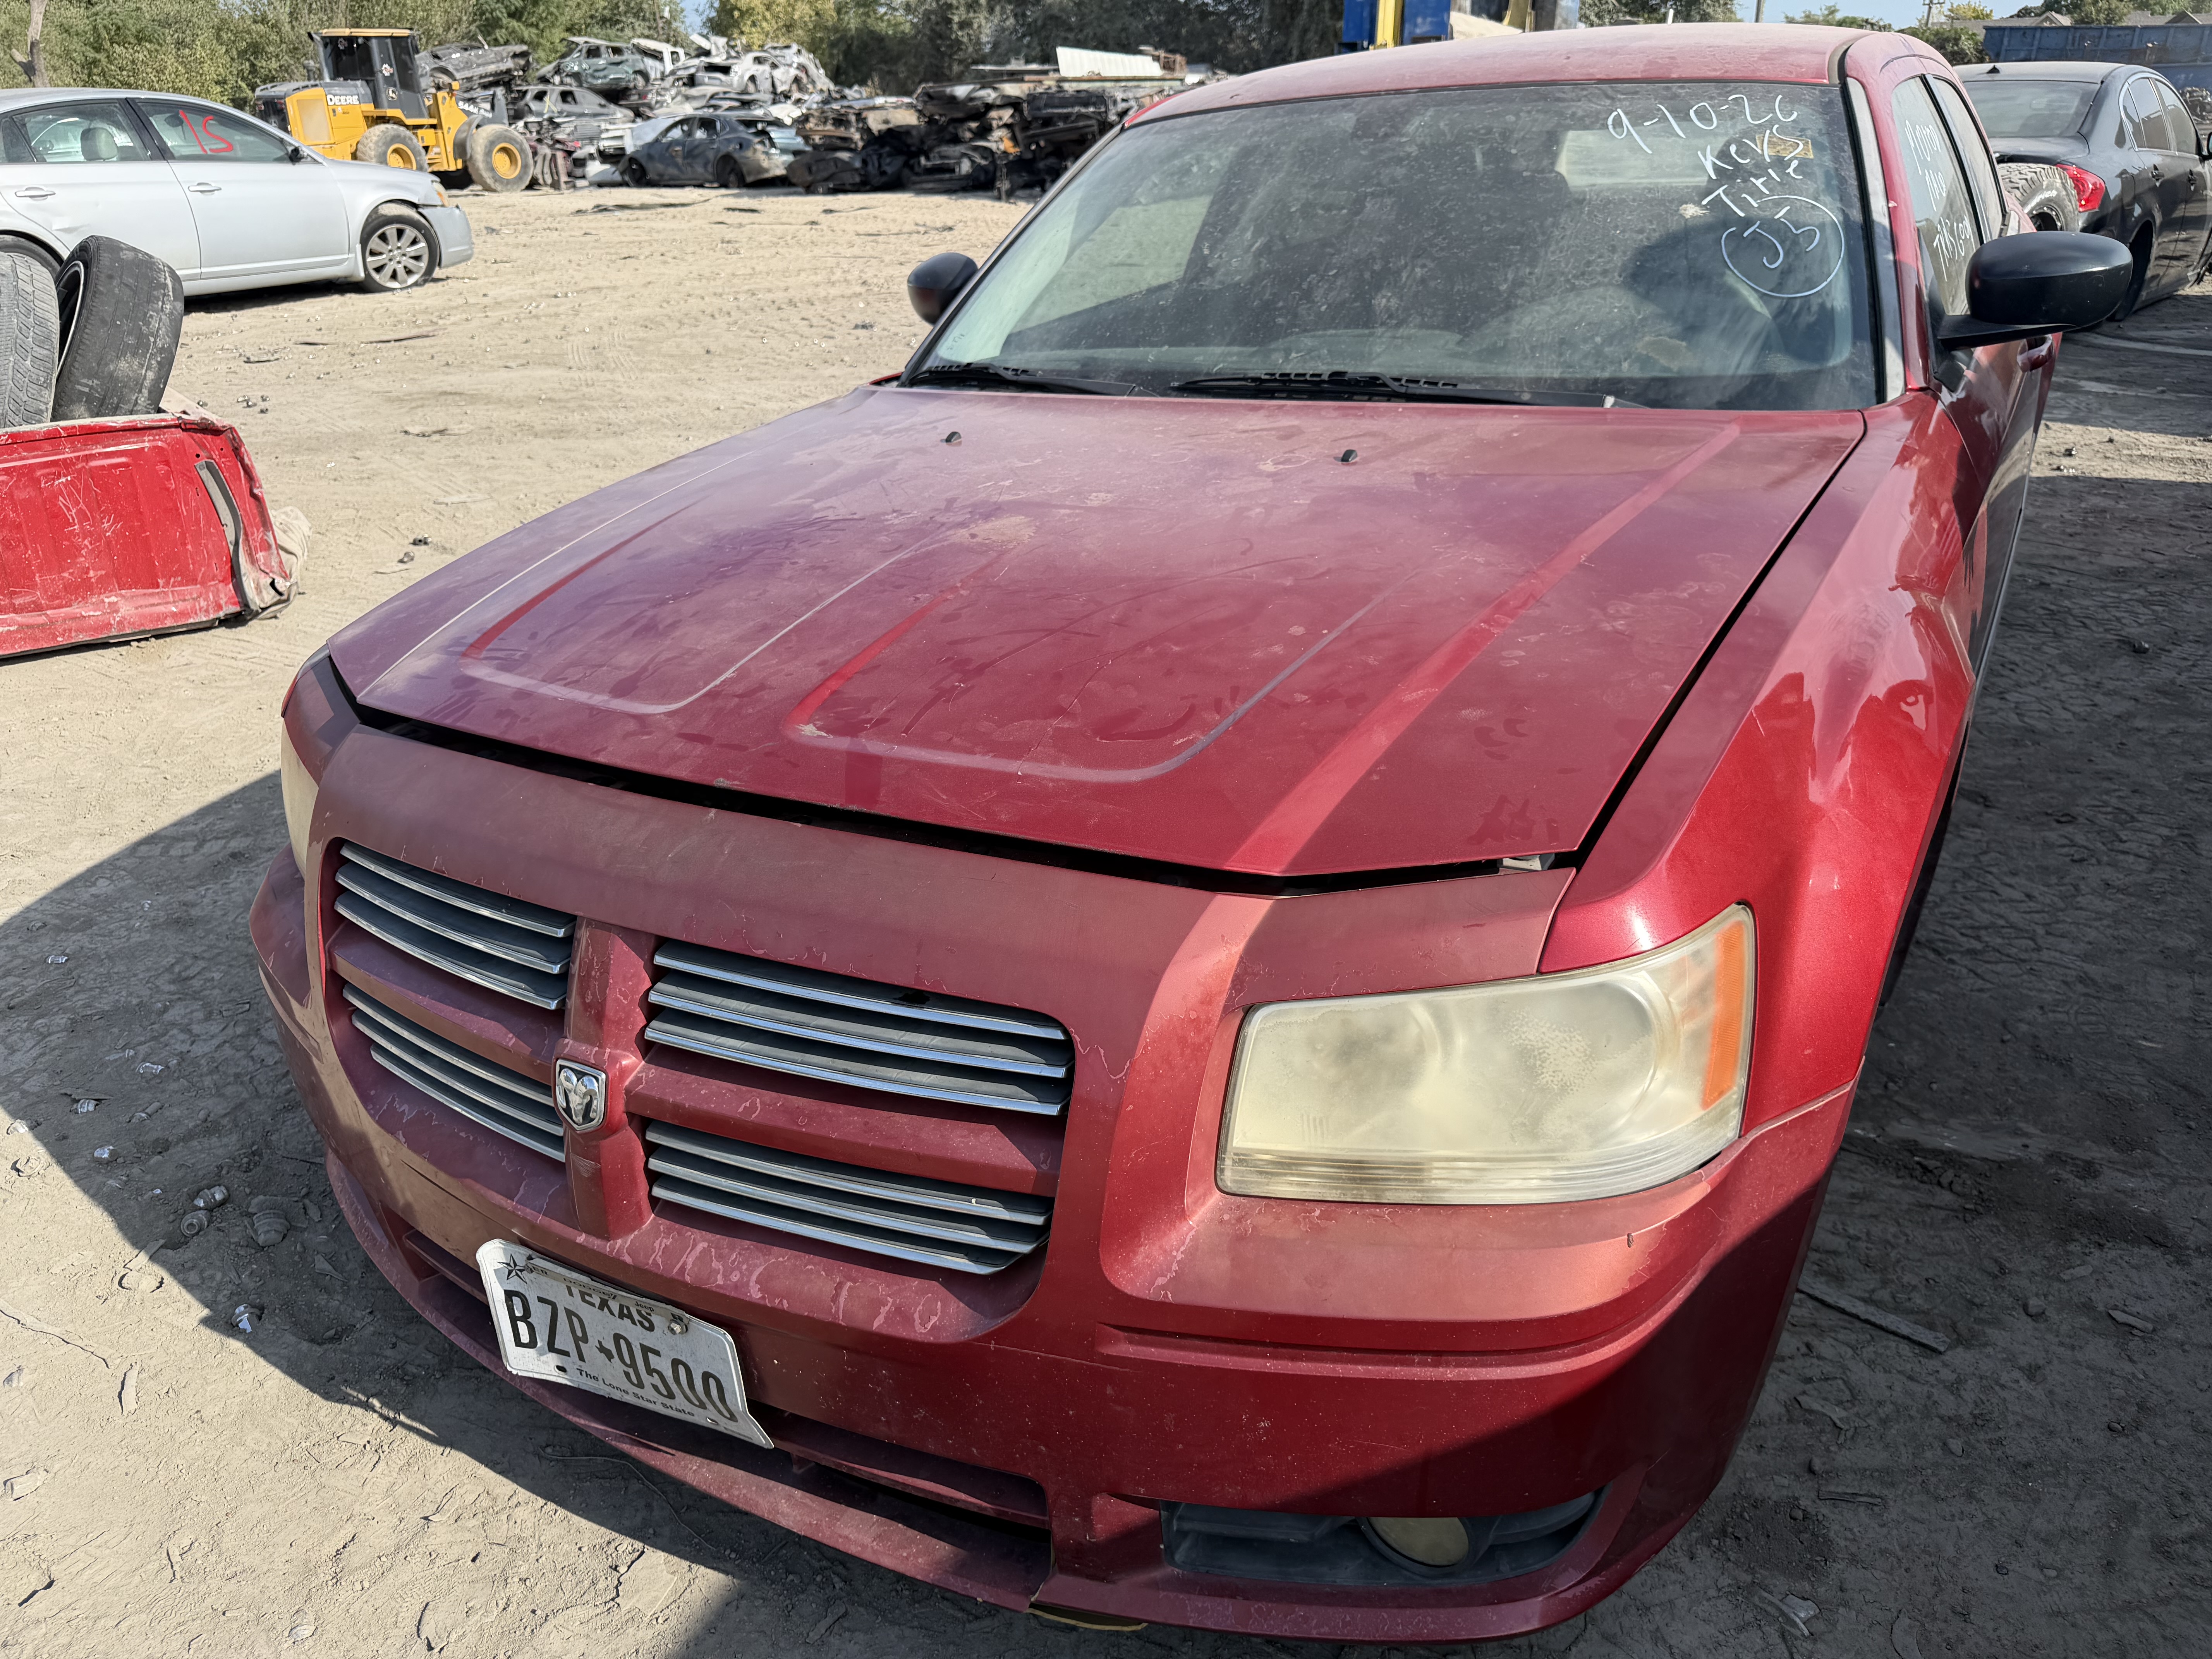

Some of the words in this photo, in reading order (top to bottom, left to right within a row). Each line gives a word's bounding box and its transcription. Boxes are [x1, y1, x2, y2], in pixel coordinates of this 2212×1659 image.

[326, 94, 359, 105] DEERE
[635, 1301, 654, 1312] Jeep
[576, 1367, 599, 1382] The
[602, 1377, 630, 1395] Lone
[632, 1391, 657, 1405] Star
[660, 1401, 695, 1417] State
